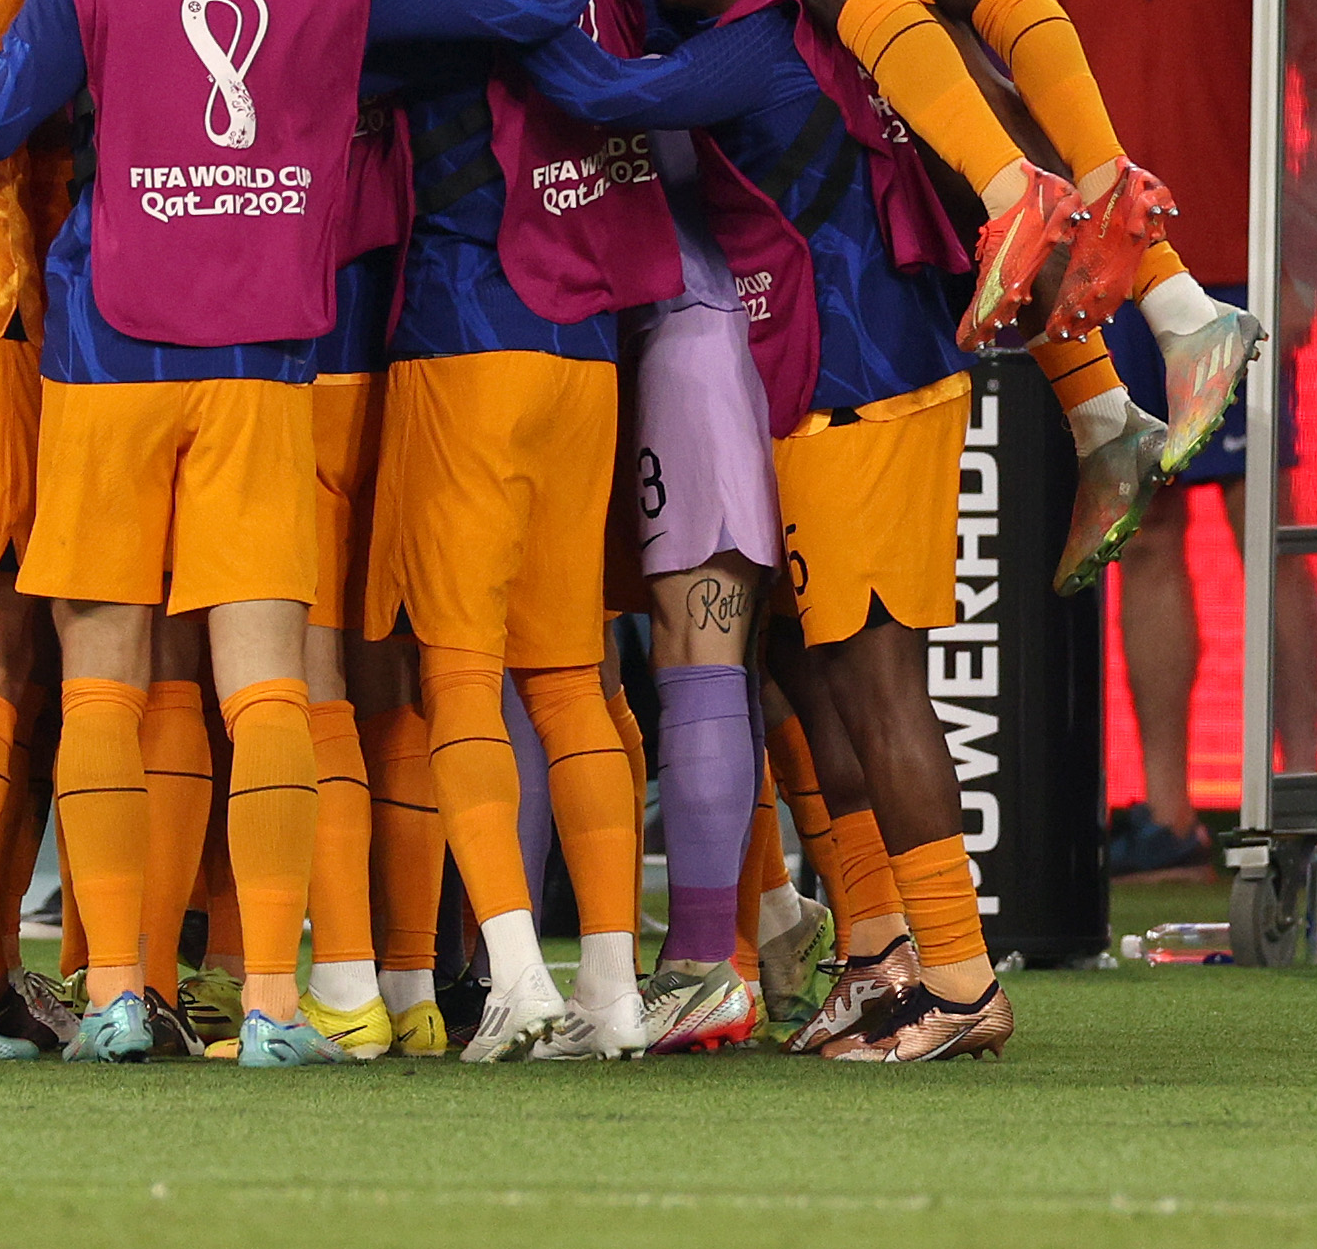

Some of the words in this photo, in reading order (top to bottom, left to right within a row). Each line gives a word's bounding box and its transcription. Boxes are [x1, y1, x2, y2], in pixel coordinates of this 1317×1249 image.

[129, 166, 187, 189] FIFA
[188, 165, 275, 189] WORLD
[278, 166, 312, 190] CUP
[533, 160, 579, 190] FIFA
[743, 271, 773, 295] CUP
[638, 447, 667, 519] 3
